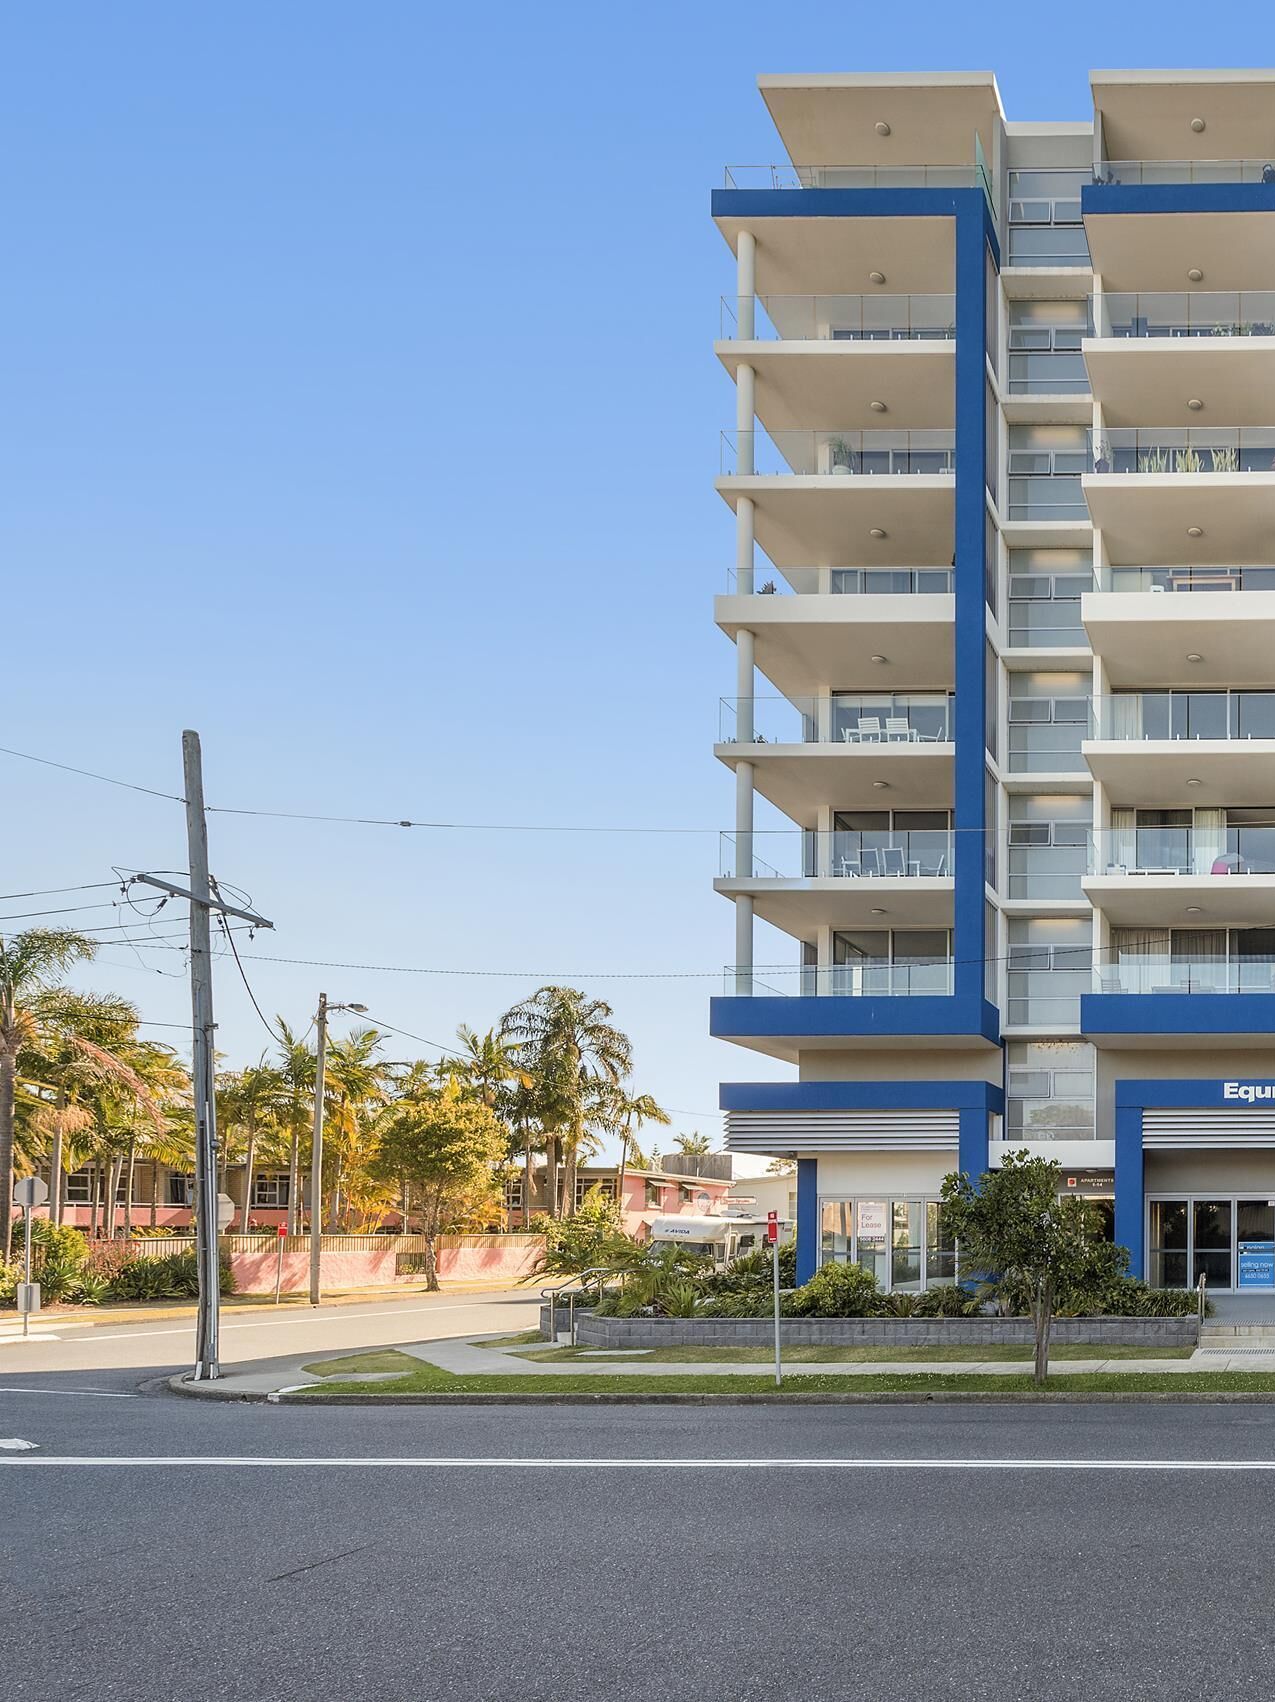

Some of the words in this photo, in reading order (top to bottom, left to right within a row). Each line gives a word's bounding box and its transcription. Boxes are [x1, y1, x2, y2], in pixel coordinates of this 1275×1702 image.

[861, 1213, 873, 1221] For
[861, 1221, 882, 1229] Lease
[1241, 1261, 1259, 1269] selling
